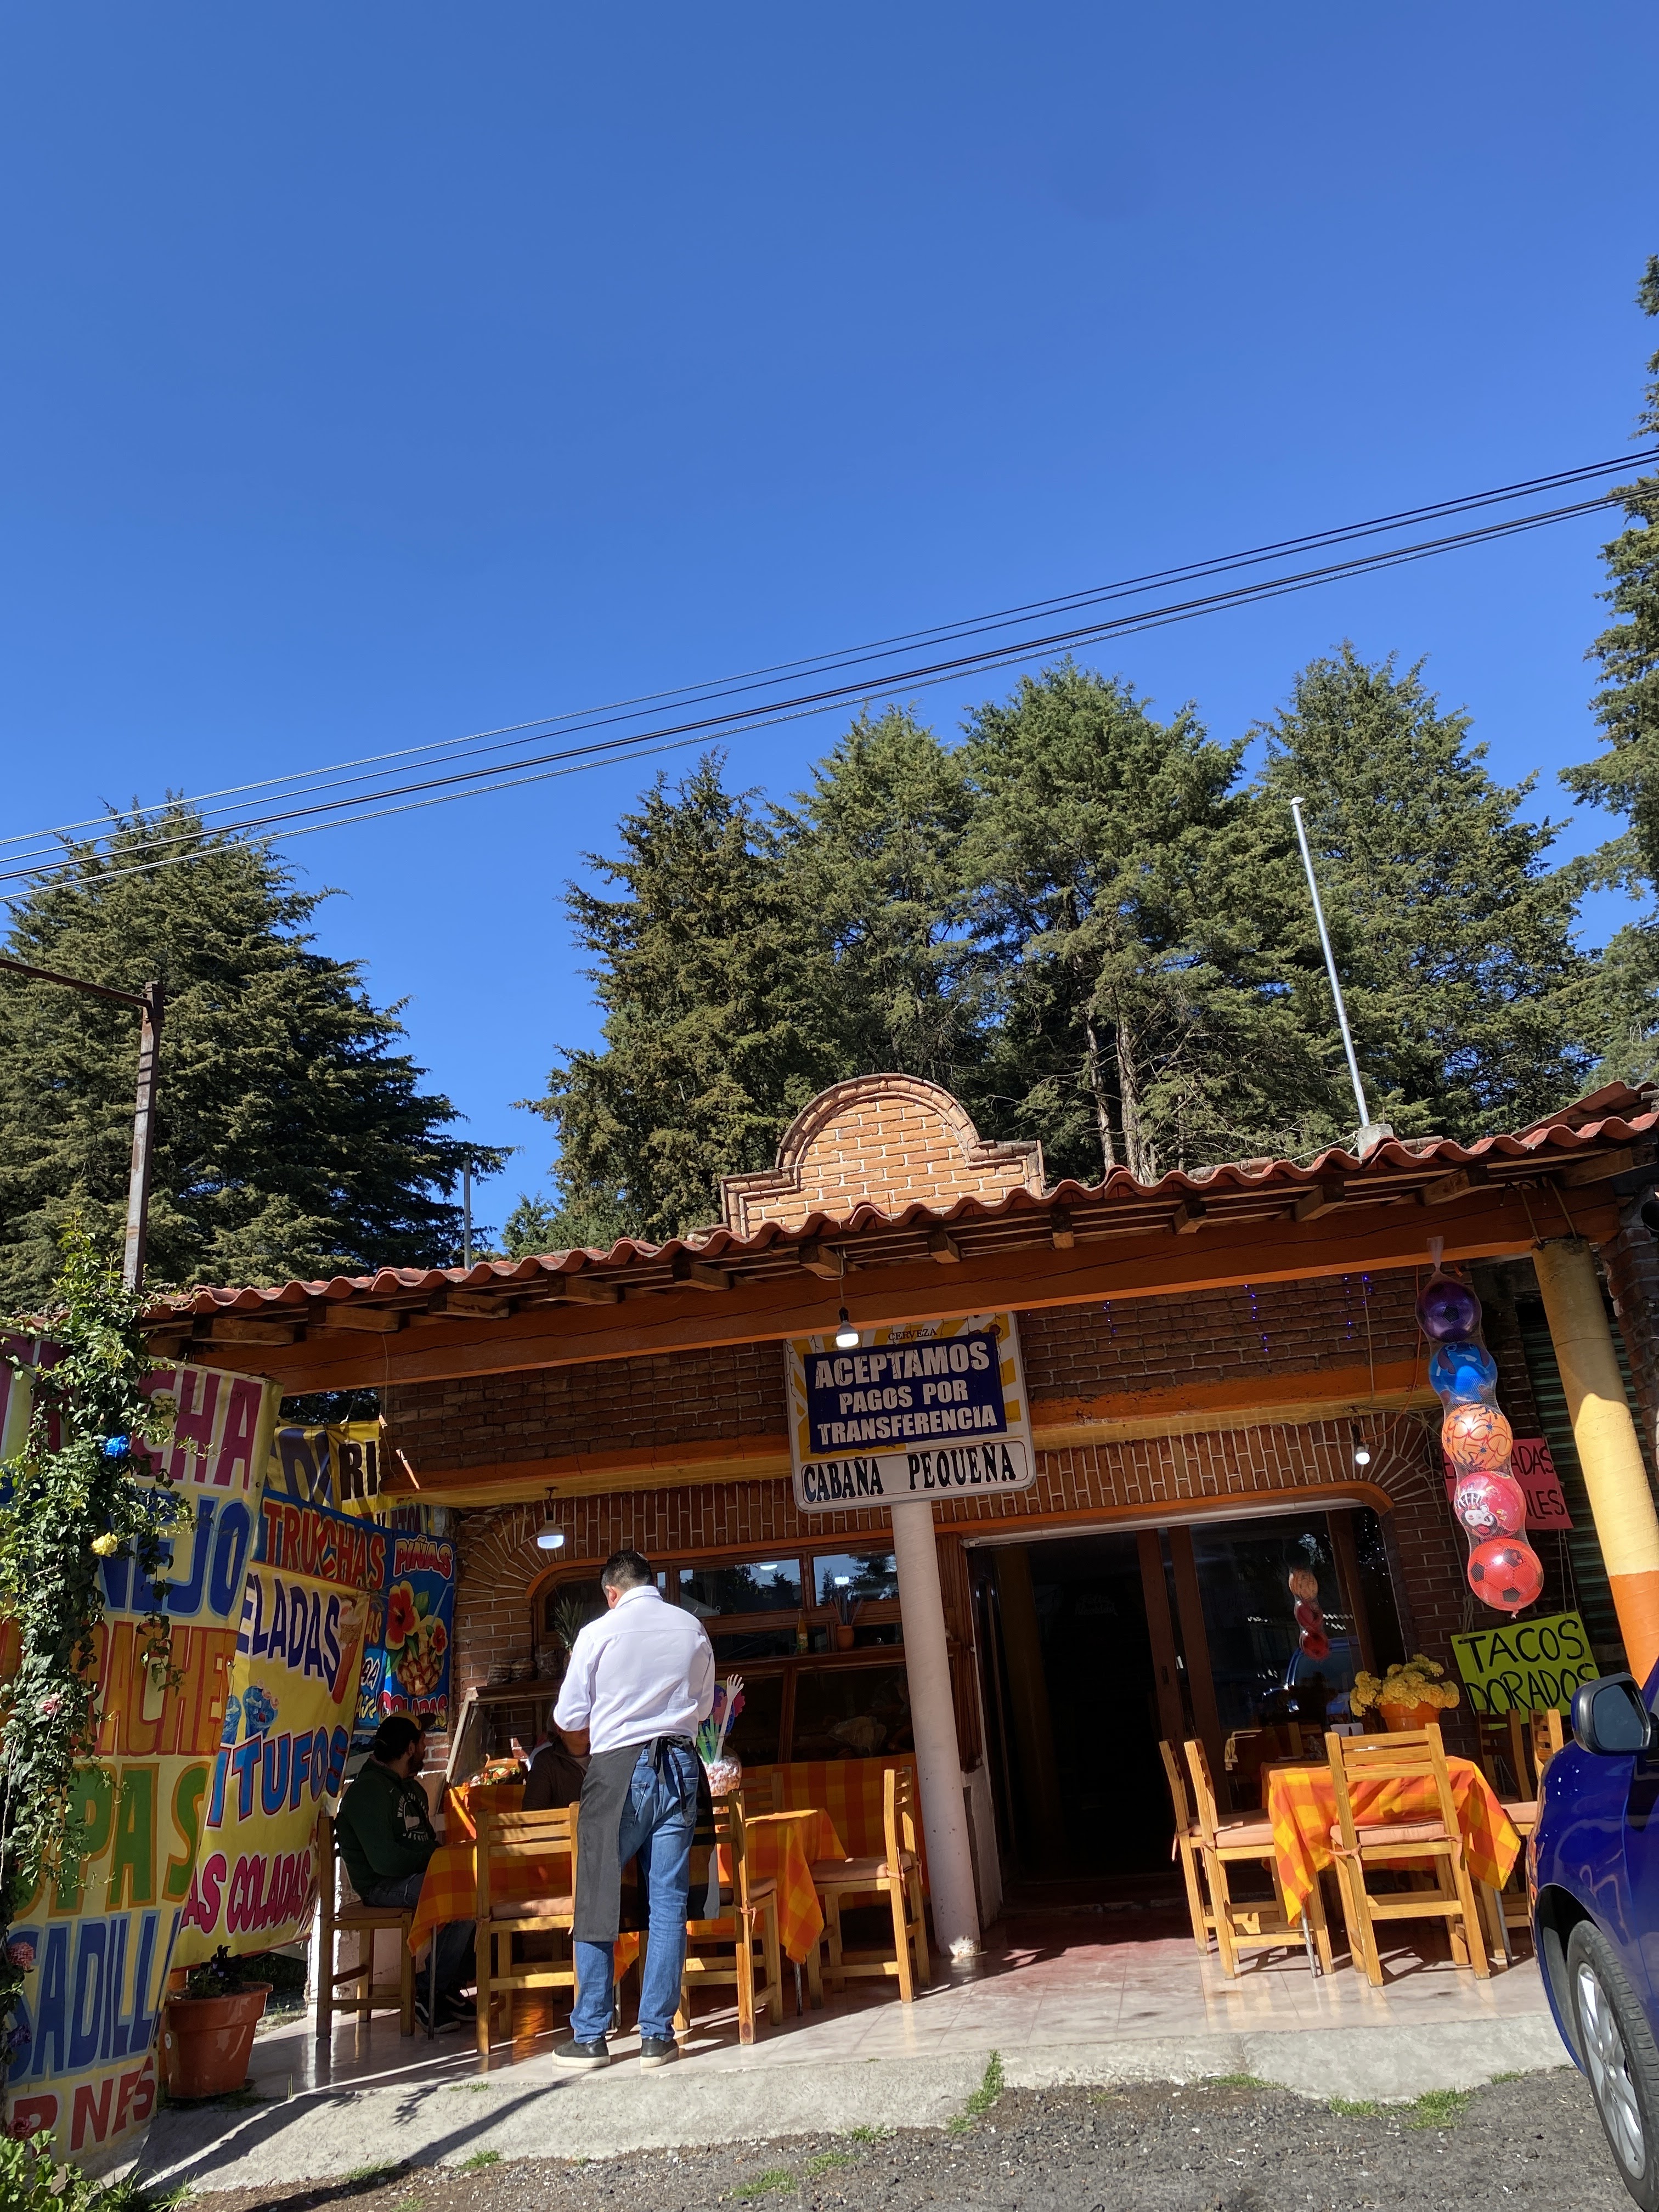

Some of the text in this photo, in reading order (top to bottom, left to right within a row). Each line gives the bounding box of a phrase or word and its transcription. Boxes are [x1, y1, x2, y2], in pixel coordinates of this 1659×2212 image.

[888, 1328, 938, 1341] CERVEZA
[815, 1341, 990, 1389] ACEPTAMOS
[839, 1379, 968, 1415] PAGOS POR
[817, 1404, 997, 1446] TRANSFERENCIA
[803, 1442, 1017, 1502] CABAÑA PEQUEÑA
[263, 1498, 385, 1590] TRUCHAS
[393, 1534, 454, 1580] PIÑAS
[1457, 1619, 1585, 1674] TACOS
[227, 1849, 311, 1934] COLADAS
